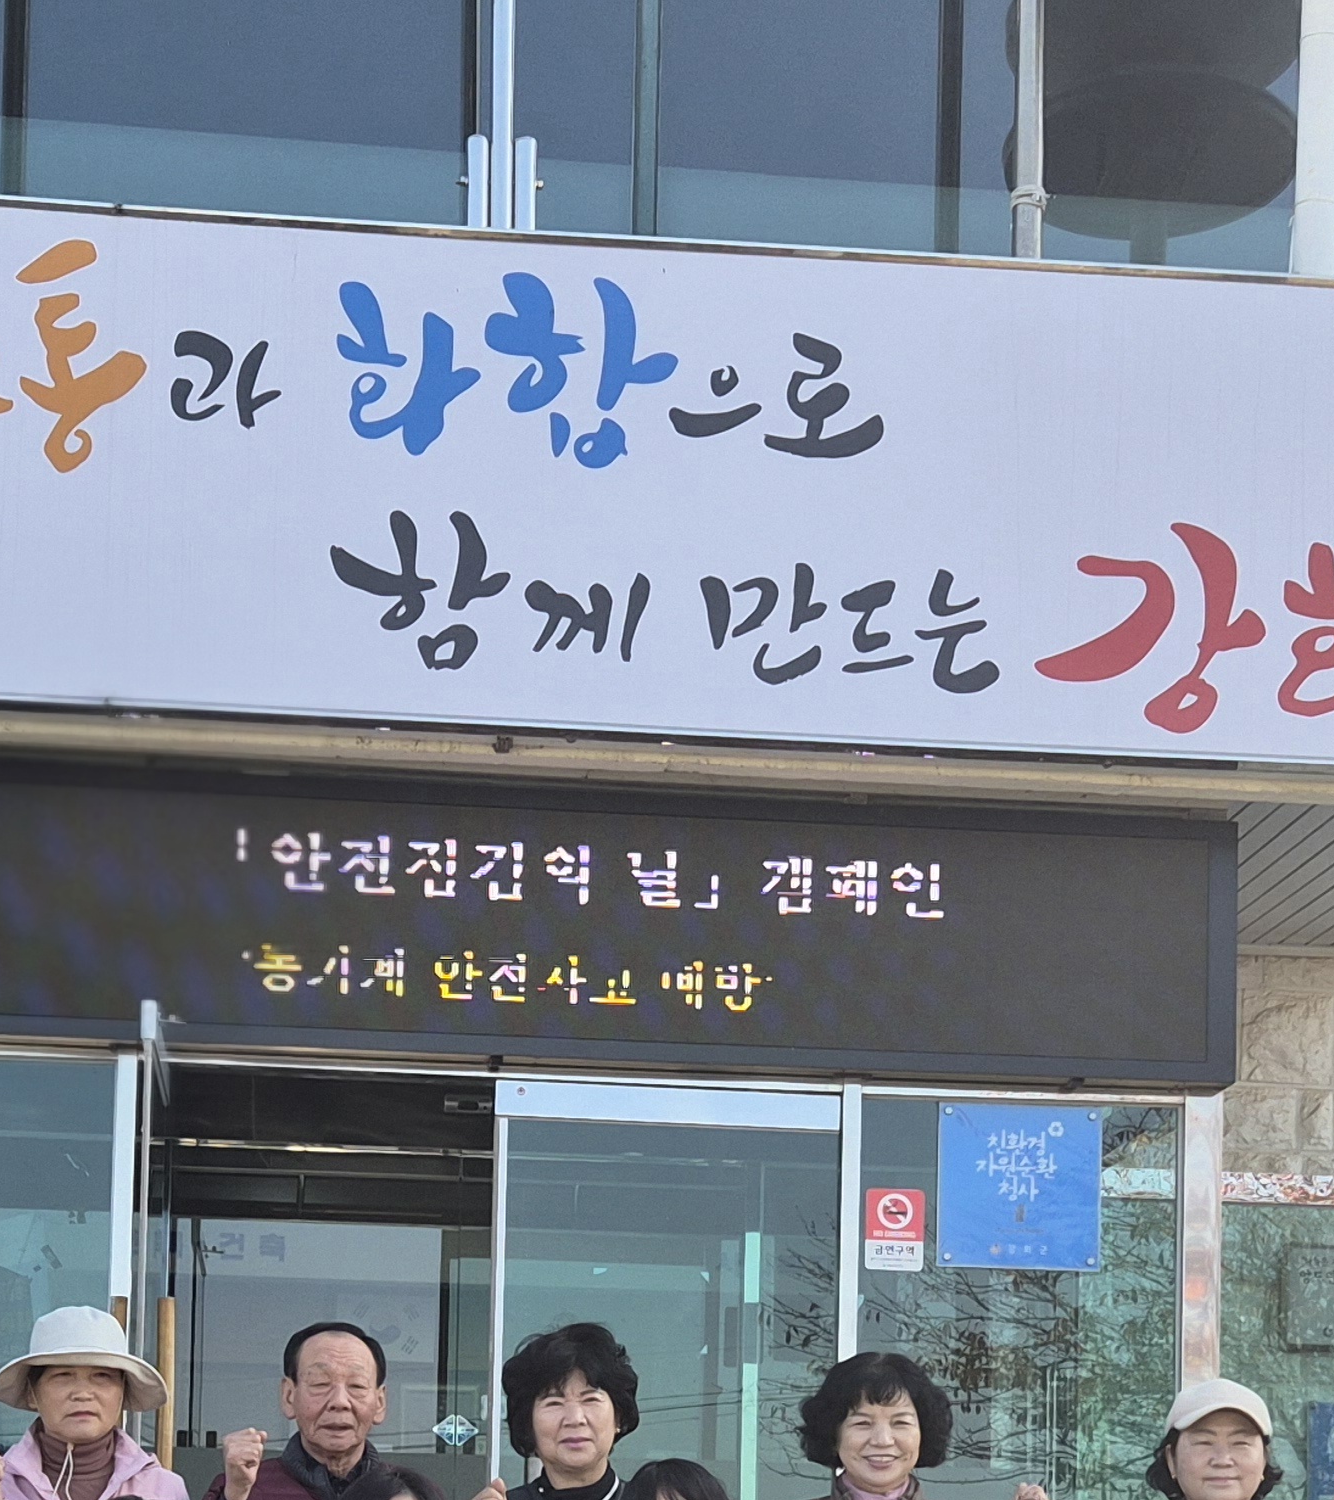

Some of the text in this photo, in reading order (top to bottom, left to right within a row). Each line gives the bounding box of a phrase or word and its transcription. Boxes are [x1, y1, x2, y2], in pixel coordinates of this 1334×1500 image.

[330, 511, 650, 670] 함께
[700, 563, 999, 693] 만드는
[987, 1129, 1047, 1157] 친환경
[976, 1152, 1058, 1179] 자원순환
[998, 1176, 1039, 1202] 청사
[875, 1245, 915, 1256] 금연구역
